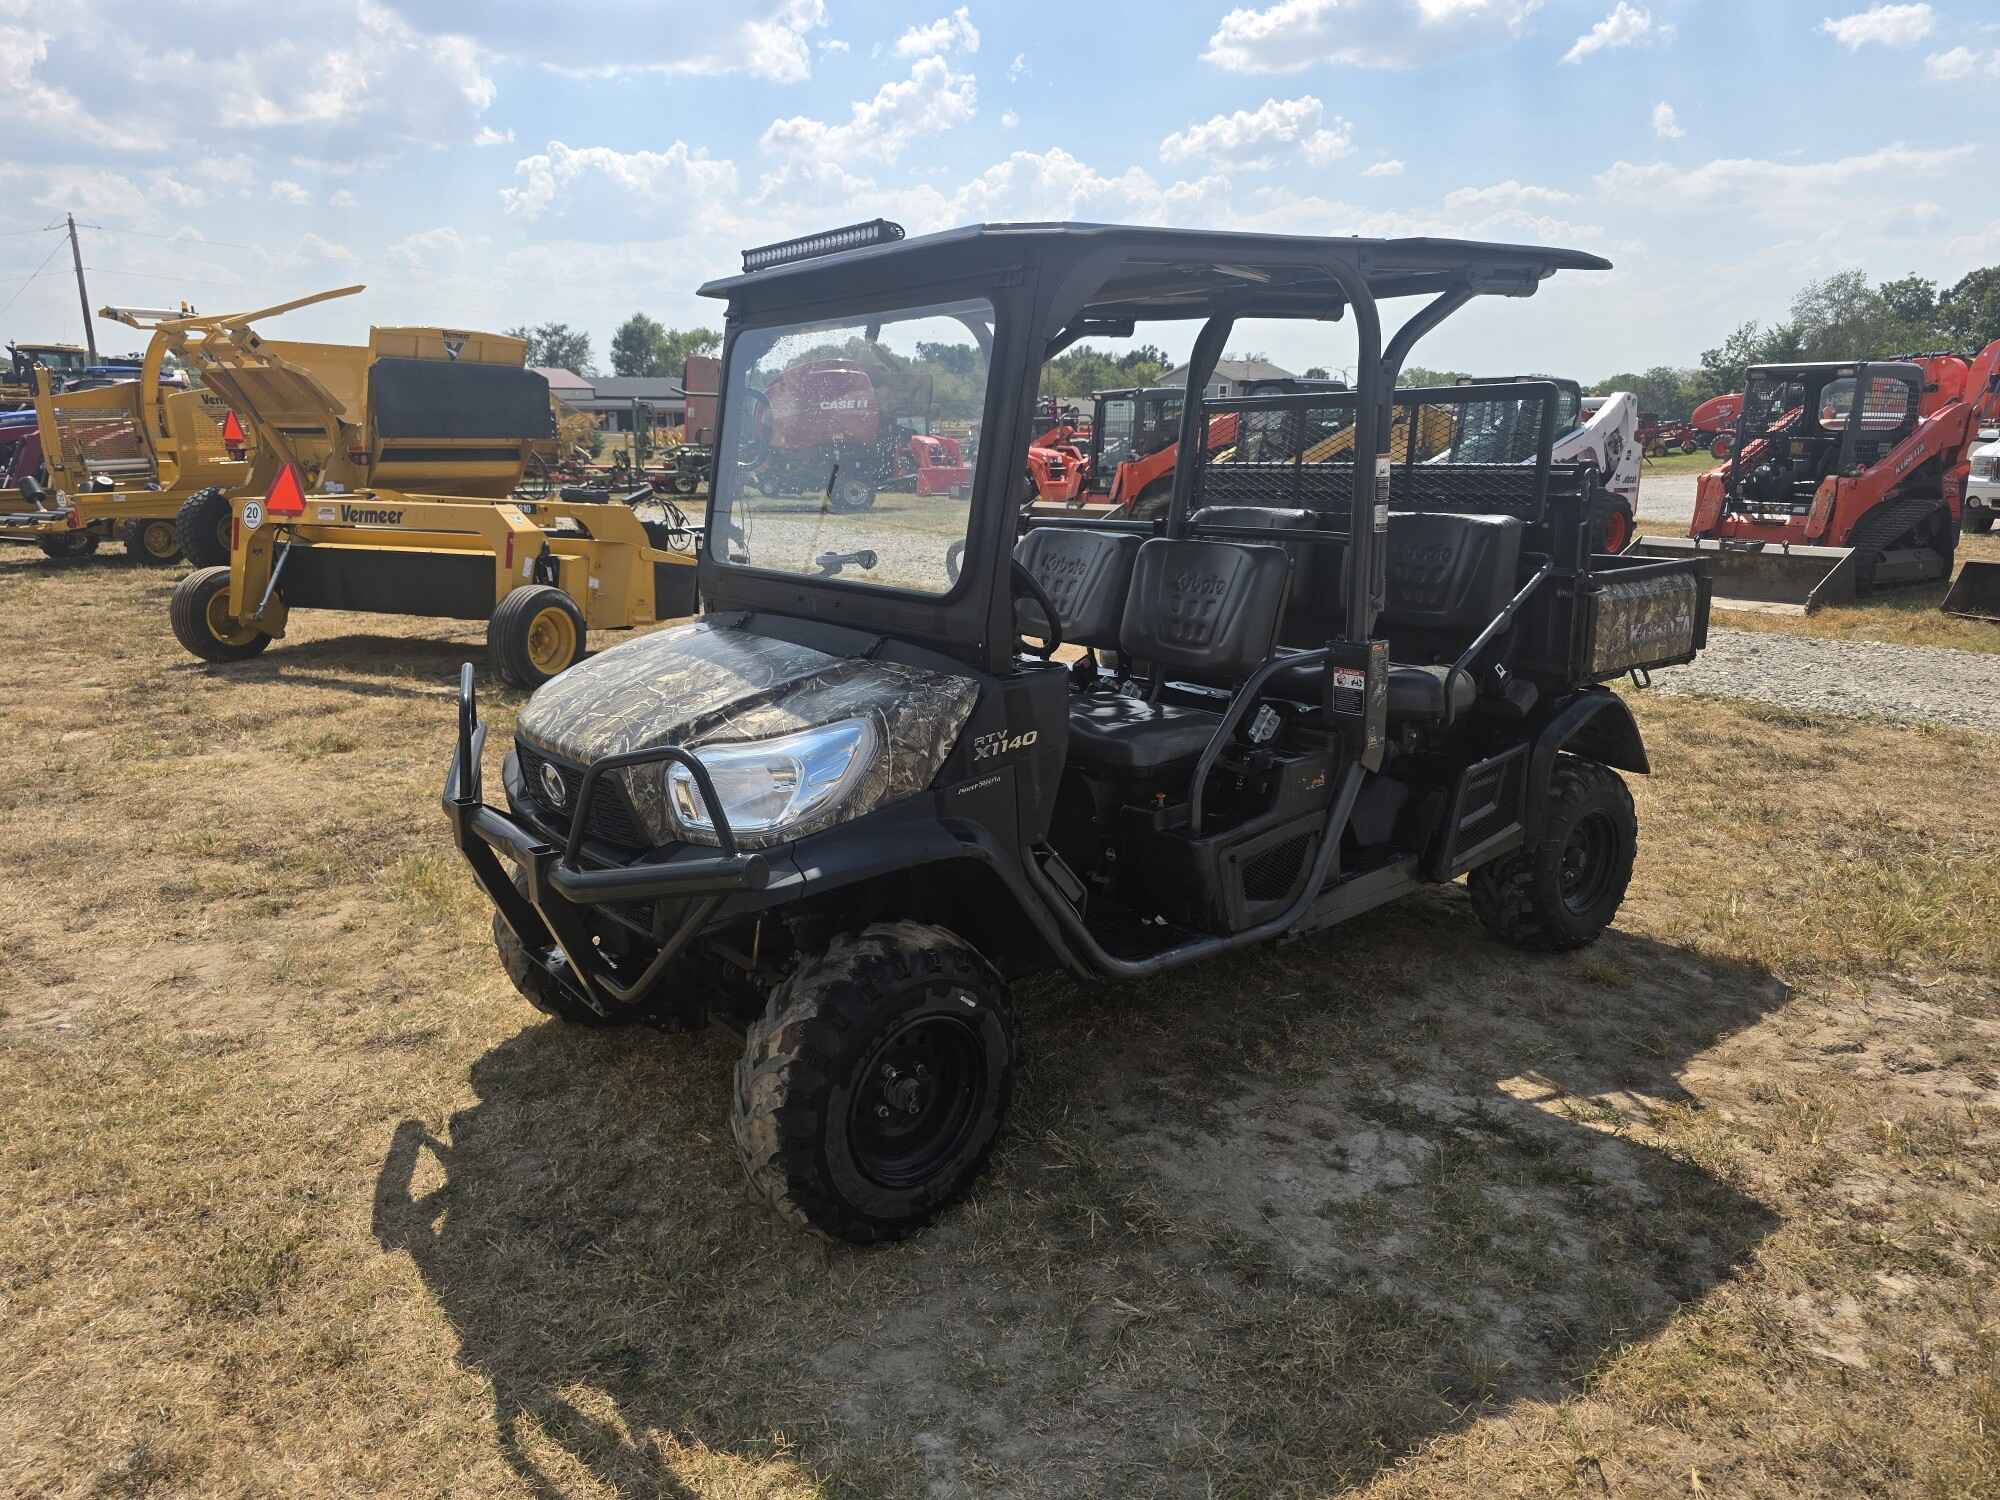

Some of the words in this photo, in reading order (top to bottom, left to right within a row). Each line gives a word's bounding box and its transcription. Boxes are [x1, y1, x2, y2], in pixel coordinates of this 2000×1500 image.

[820, 399, 856, 410] CASE
[246, 506, 258, 520] 20
[340, 504, 403, 525] Vermeer
[974, 729, 1008, 746] RTV
[974, 730, 1038, 761] X1140
